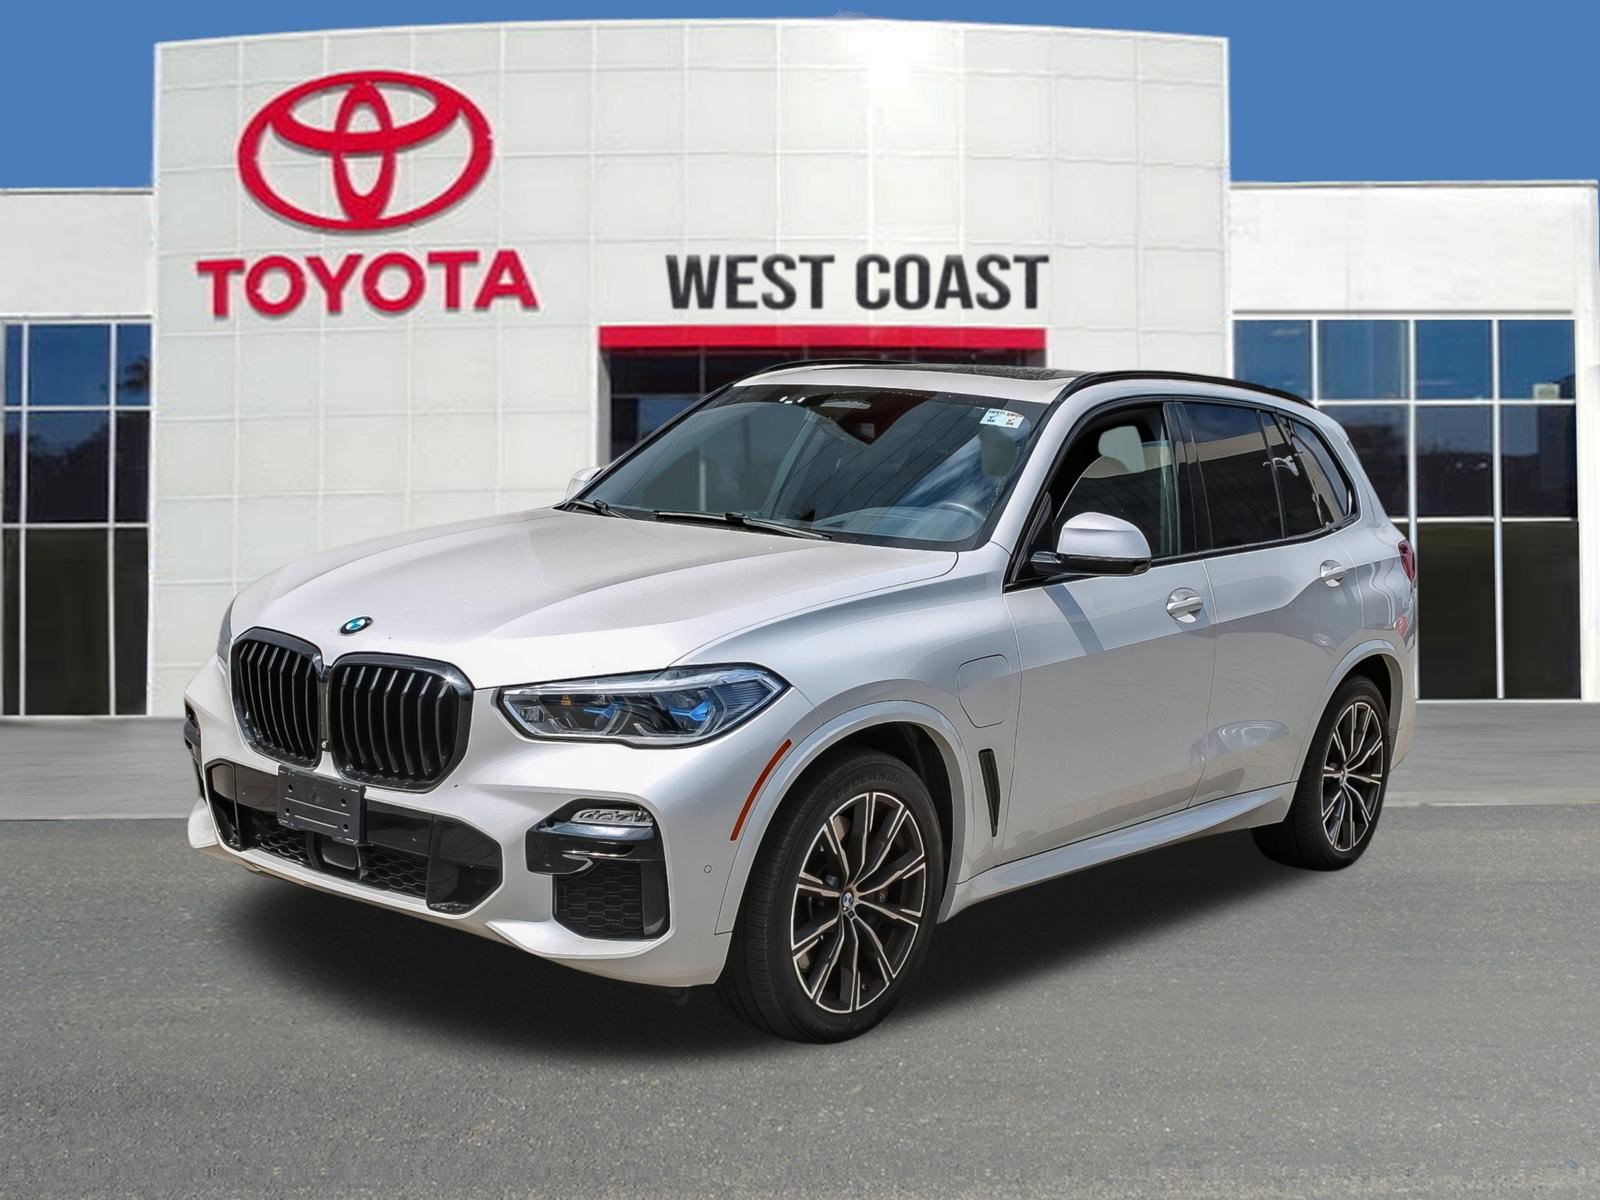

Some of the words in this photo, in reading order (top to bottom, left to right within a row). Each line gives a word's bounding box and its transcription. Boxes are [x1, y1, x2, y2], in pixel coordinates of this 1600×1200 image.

[197, 250, 539, 319] TOYOTA
[665, 254, 835, 310] WEST
[855, 254, 1049, 311] COAST
